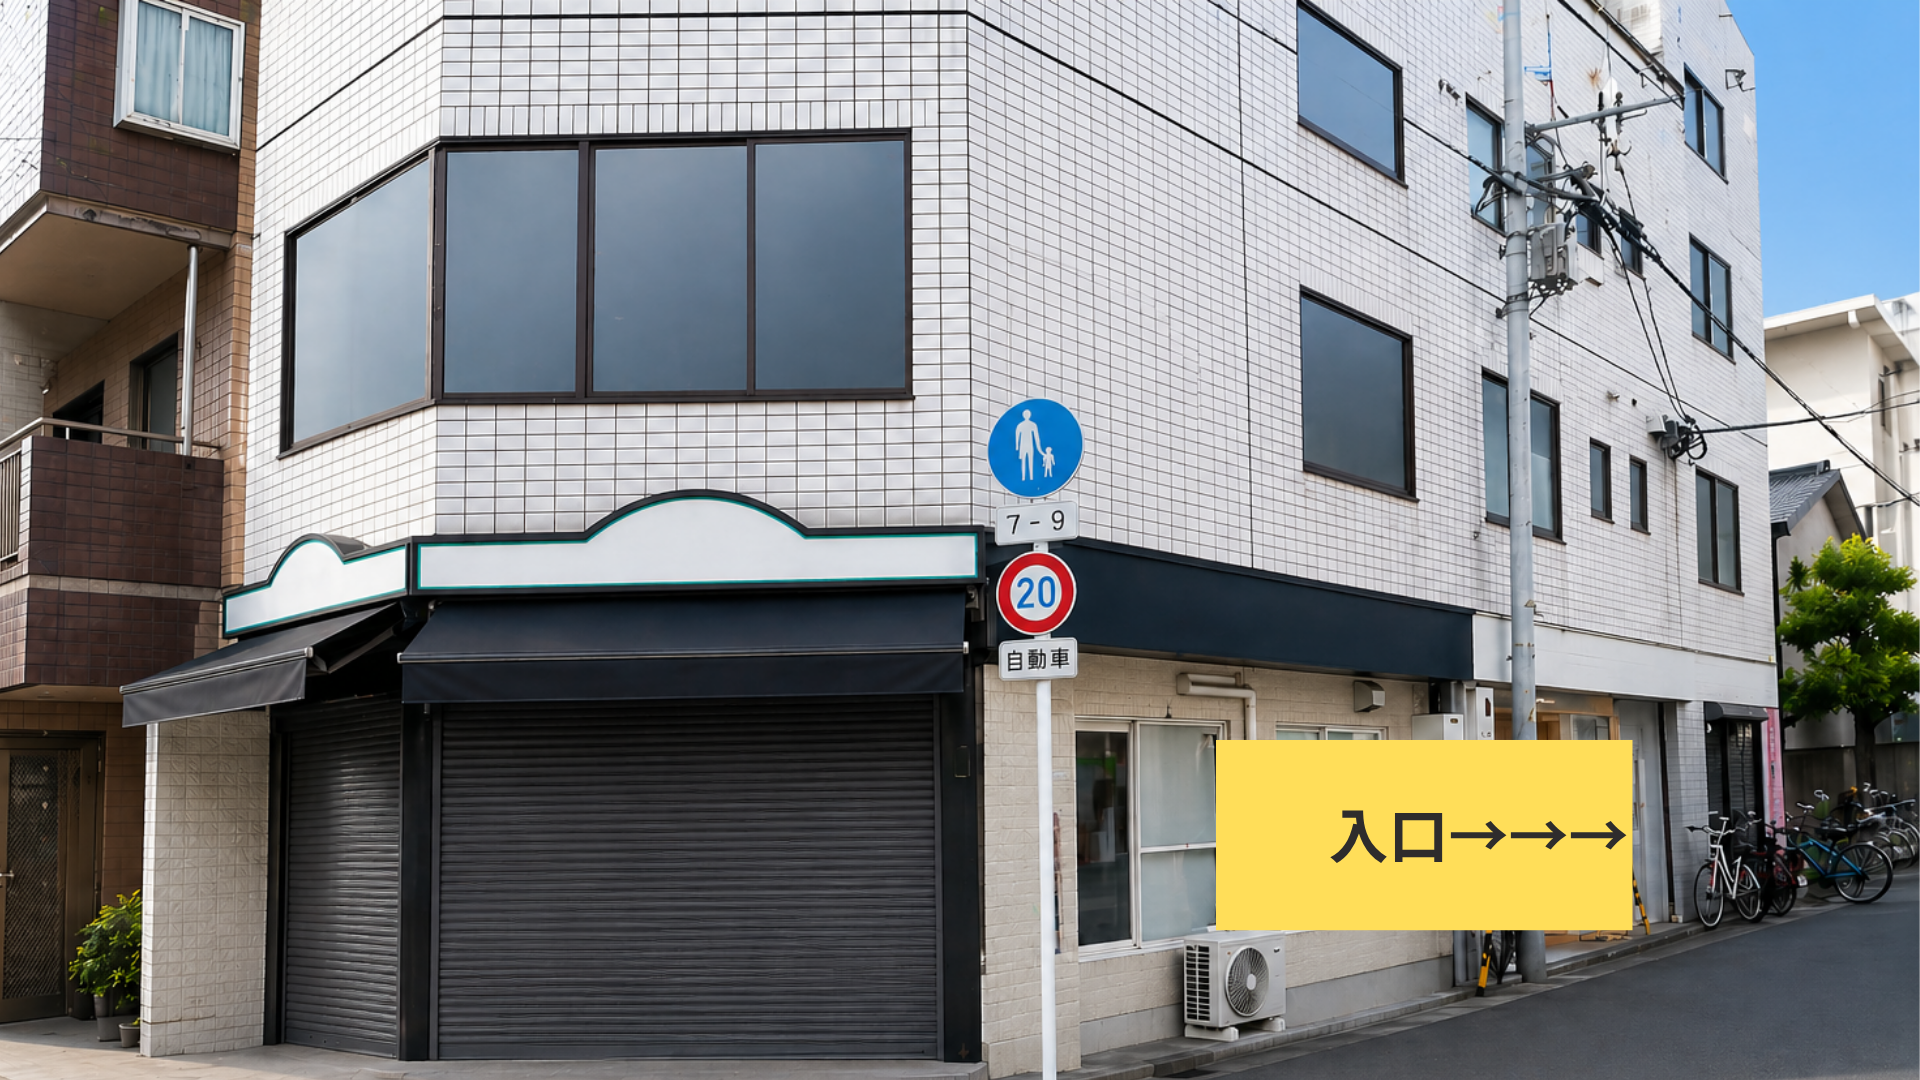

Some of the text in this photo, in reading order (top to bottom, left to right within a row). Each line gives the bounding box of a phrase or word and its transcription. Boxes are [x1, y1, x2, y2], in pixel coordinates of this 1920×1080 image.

[1016, 575, 1056, 609] 20
[1007, 647, 1070, 672] 自動車
